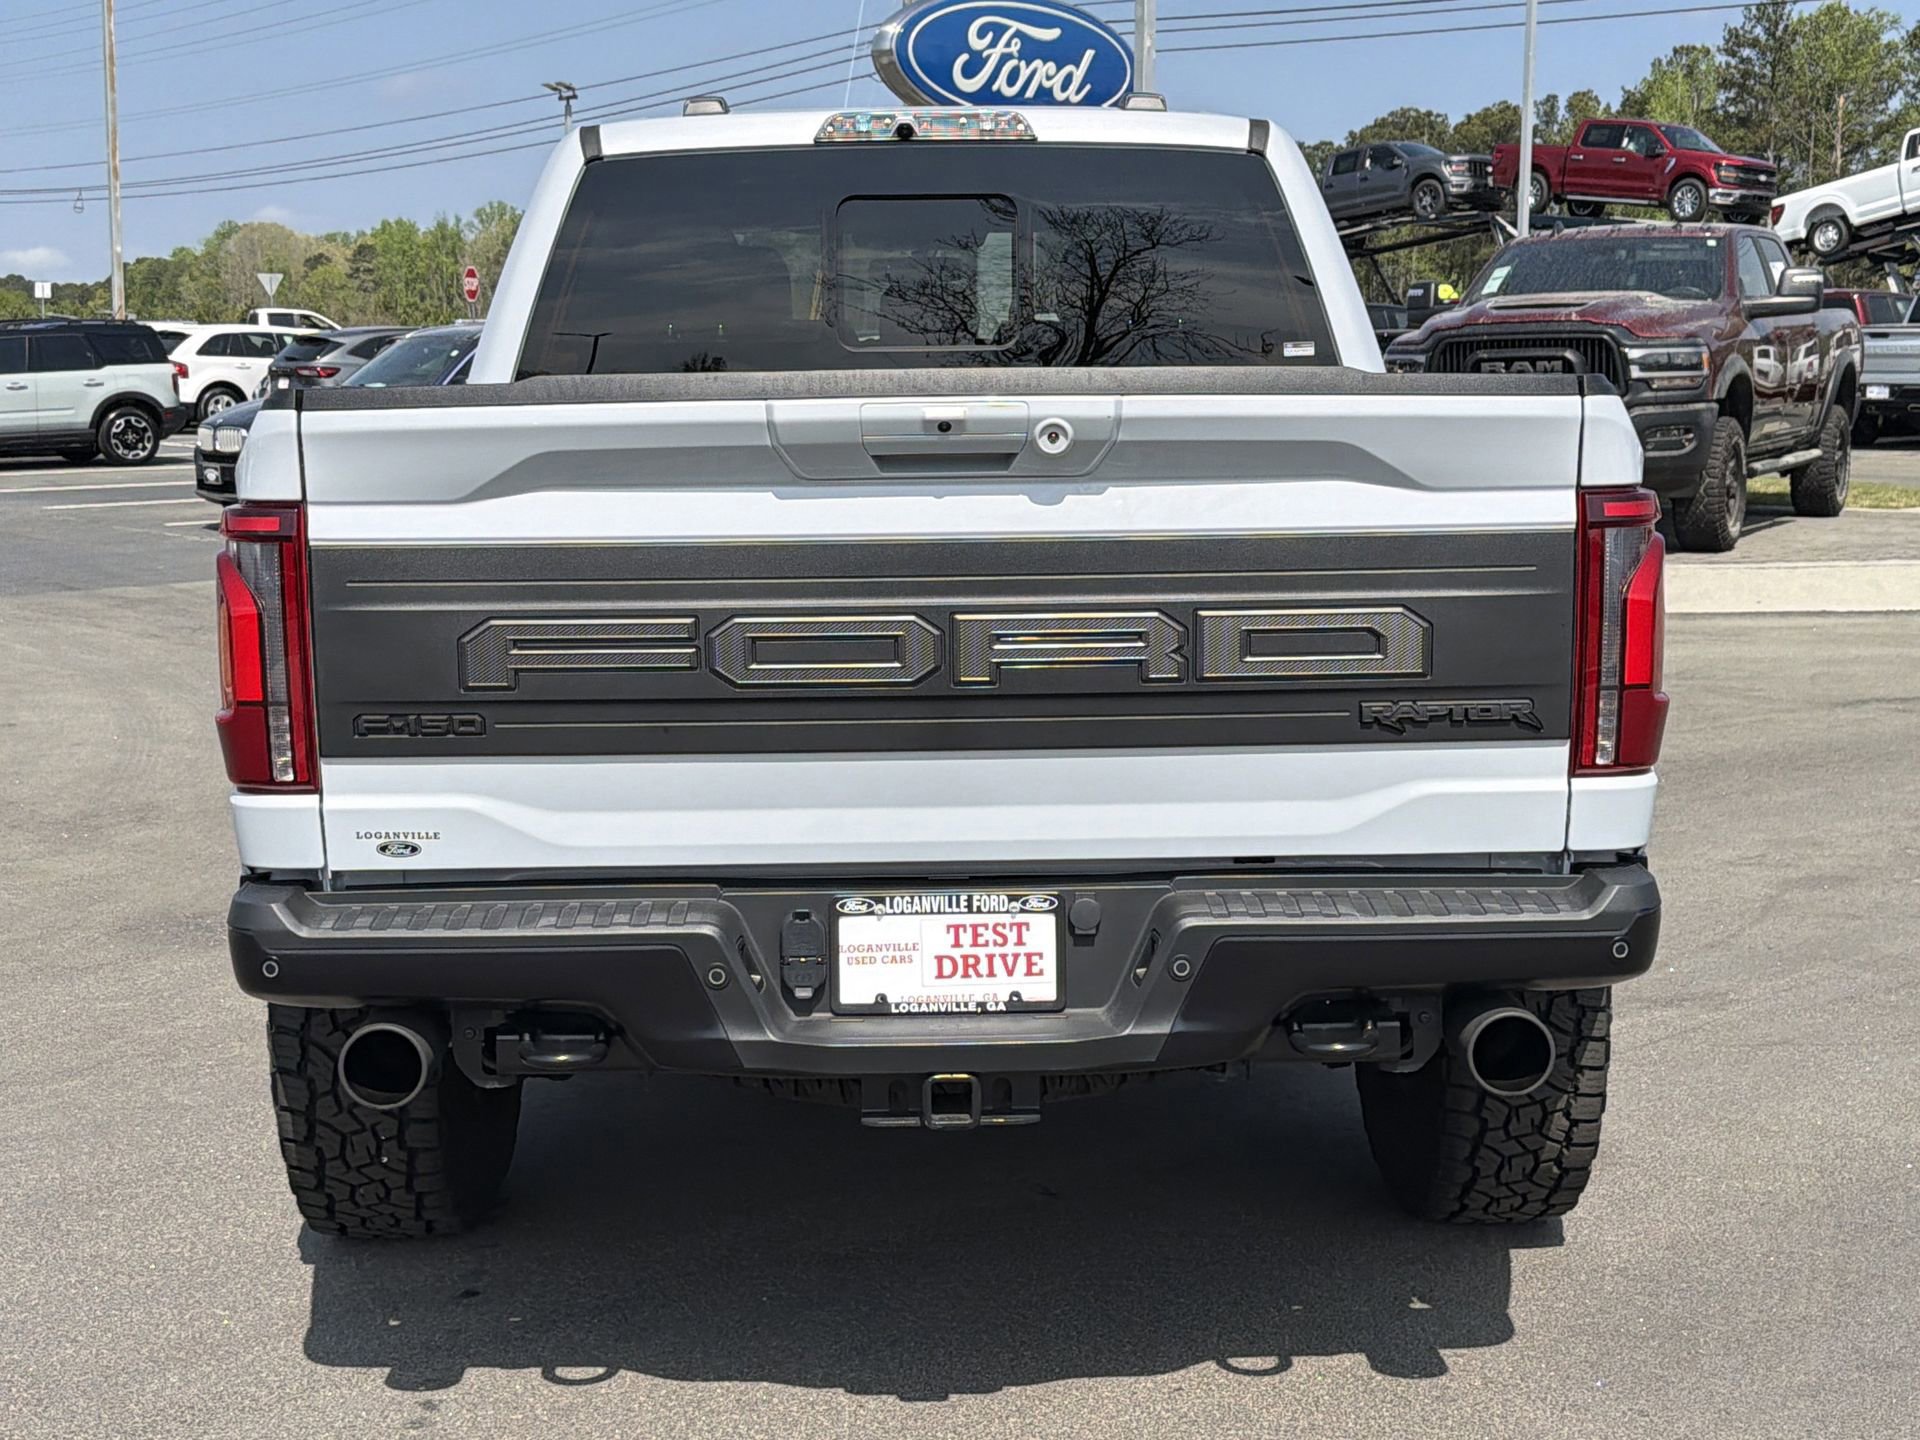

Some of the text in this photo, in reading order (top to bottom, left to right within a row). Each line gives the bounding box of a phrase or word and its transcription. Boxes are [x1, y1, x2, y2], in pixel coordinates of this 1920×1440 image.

[952, 15, 1096, 104] Ford
[1480, 360, 1563, 374] RAM
[459, 604, 1432, 692] FORD
[1360, 698, 1545, 735] RAPTOR
[355, 831, 441, 840] LOGANVILLE
[885, 894, 1009, 914] LOGANVILLE FORD
[946, 922, 1030, 948] TEST
[840, 943, 919, 953] LOGANVILLE
[847, 955, 914, 966] USED CARS
[934, 952, 1044, 979] DRIVE
[891, 1001, 1007, 1014] LOGANVILLE, GA
